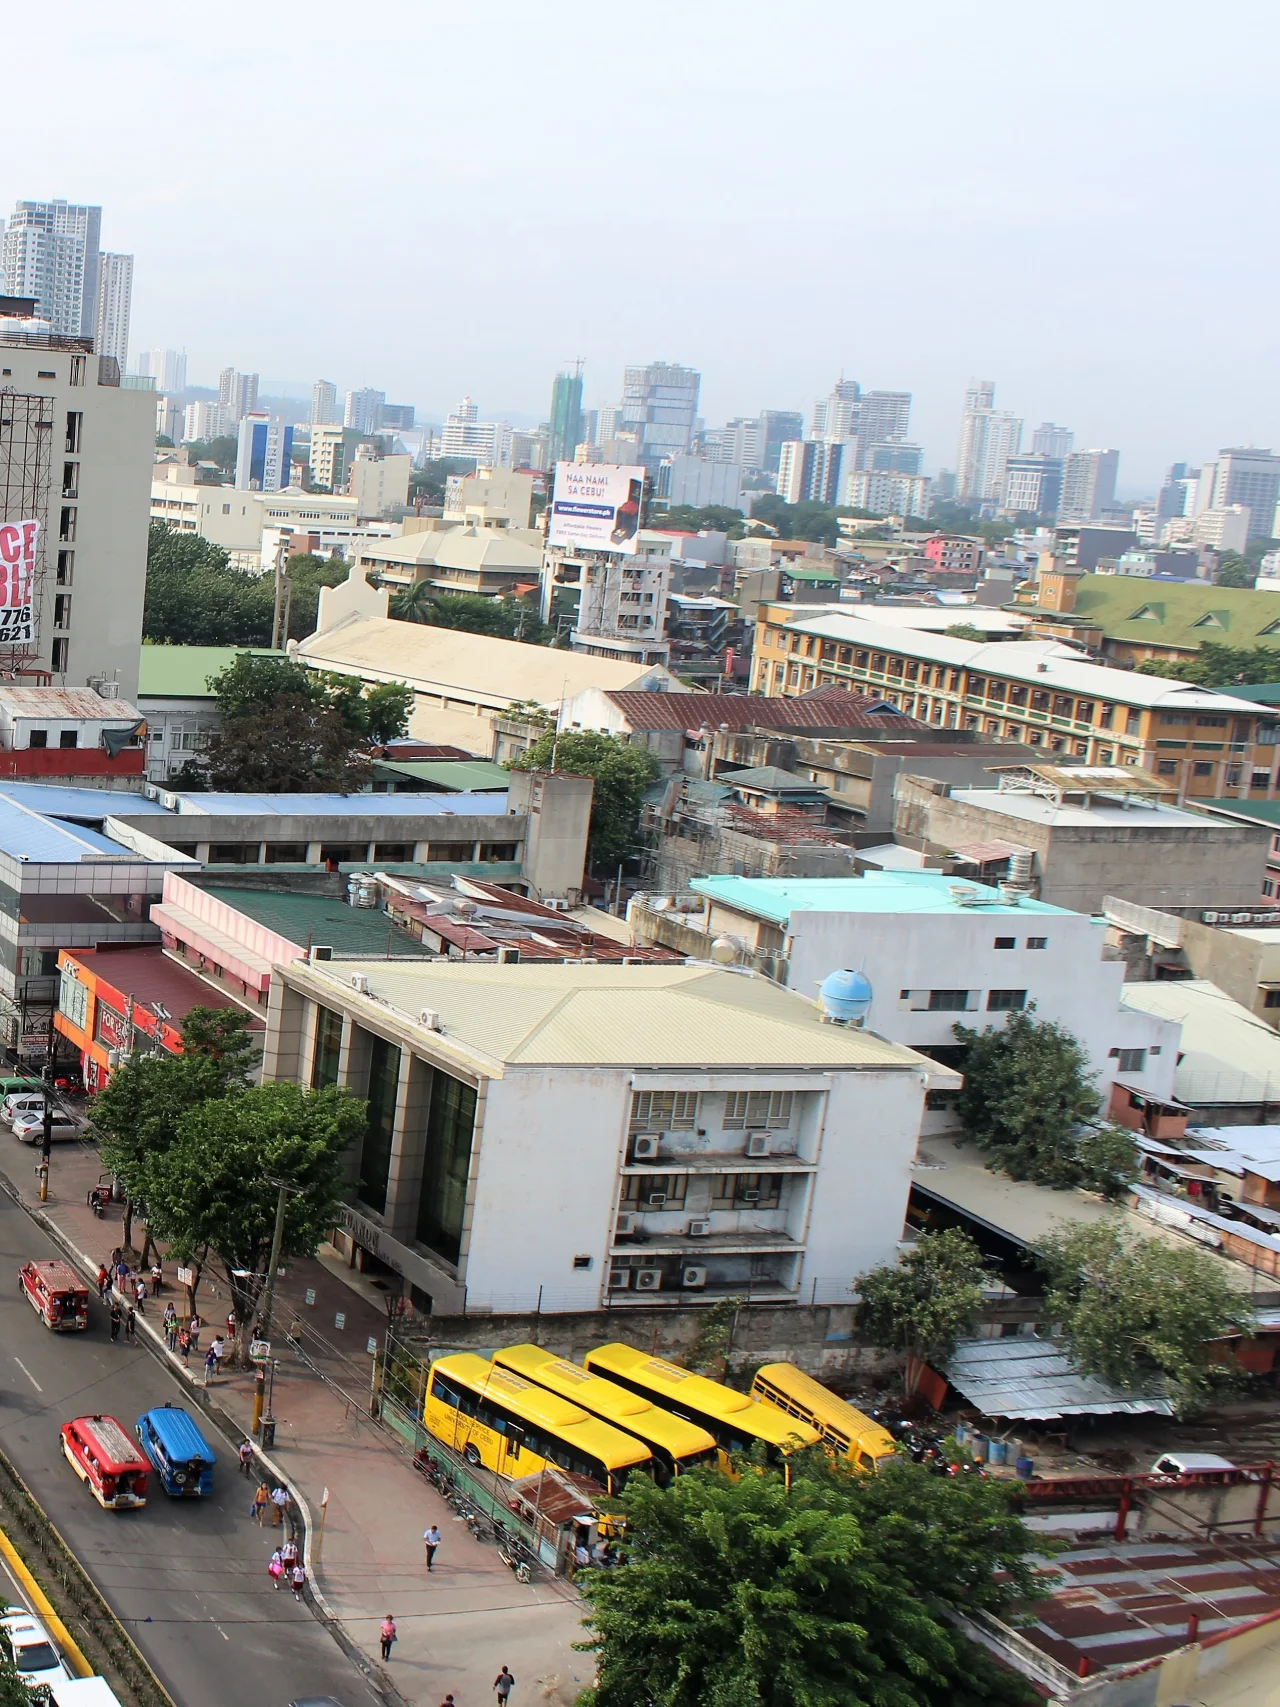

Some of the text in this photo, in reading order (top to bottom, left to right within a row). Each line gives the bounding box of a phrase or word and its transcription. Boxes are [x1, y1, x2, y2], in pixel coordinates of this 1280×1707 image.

[566, 474, 583, 484] NAA
[568, 485, 605, 497] SA CEBU!
[1, 606, 30, 625] 776
[63, 958, 80, 980] KFC
[102, 1010, 115, 1030] FOR
[472, 1421, 490, 1436] ERVICE
